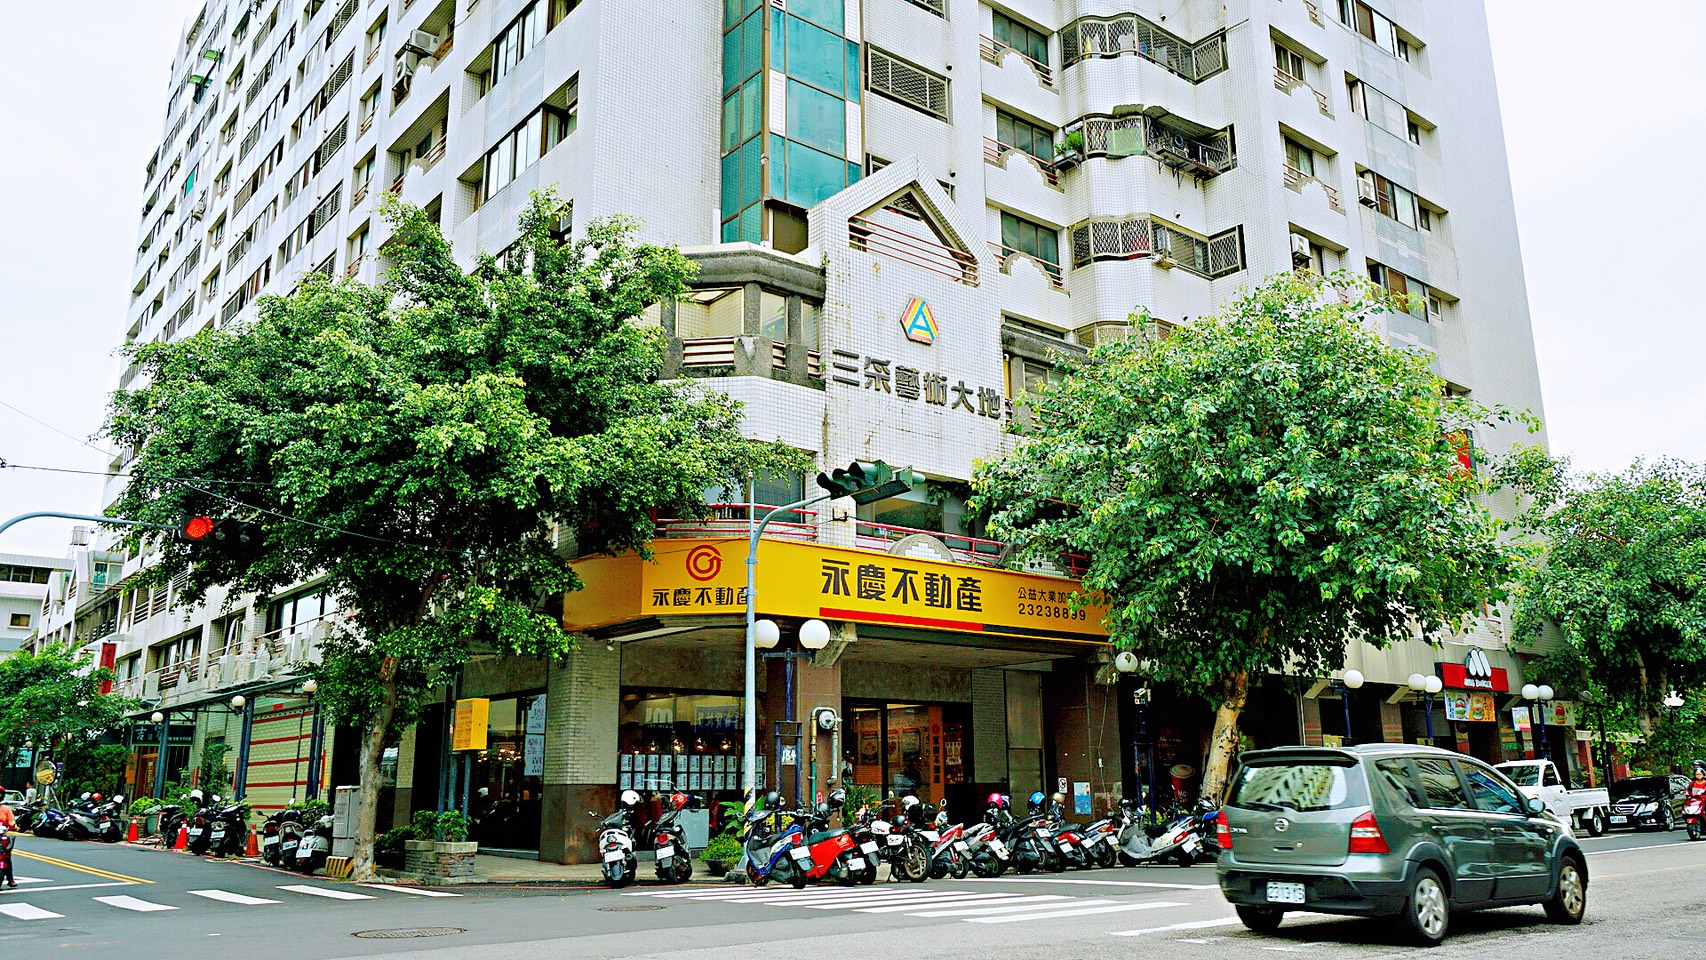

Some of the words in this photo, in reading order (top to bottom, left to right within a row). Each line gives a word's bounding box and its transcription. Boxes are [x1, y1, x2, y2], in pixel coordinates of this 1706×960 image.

[832, 348, 1002, 419] 三采藝術大地
[652, 586, 749, 606] 永慶不動產
[821, 558, 983, 613] 永慶不動產
[1018, 603, 1086, 621] 23238899
